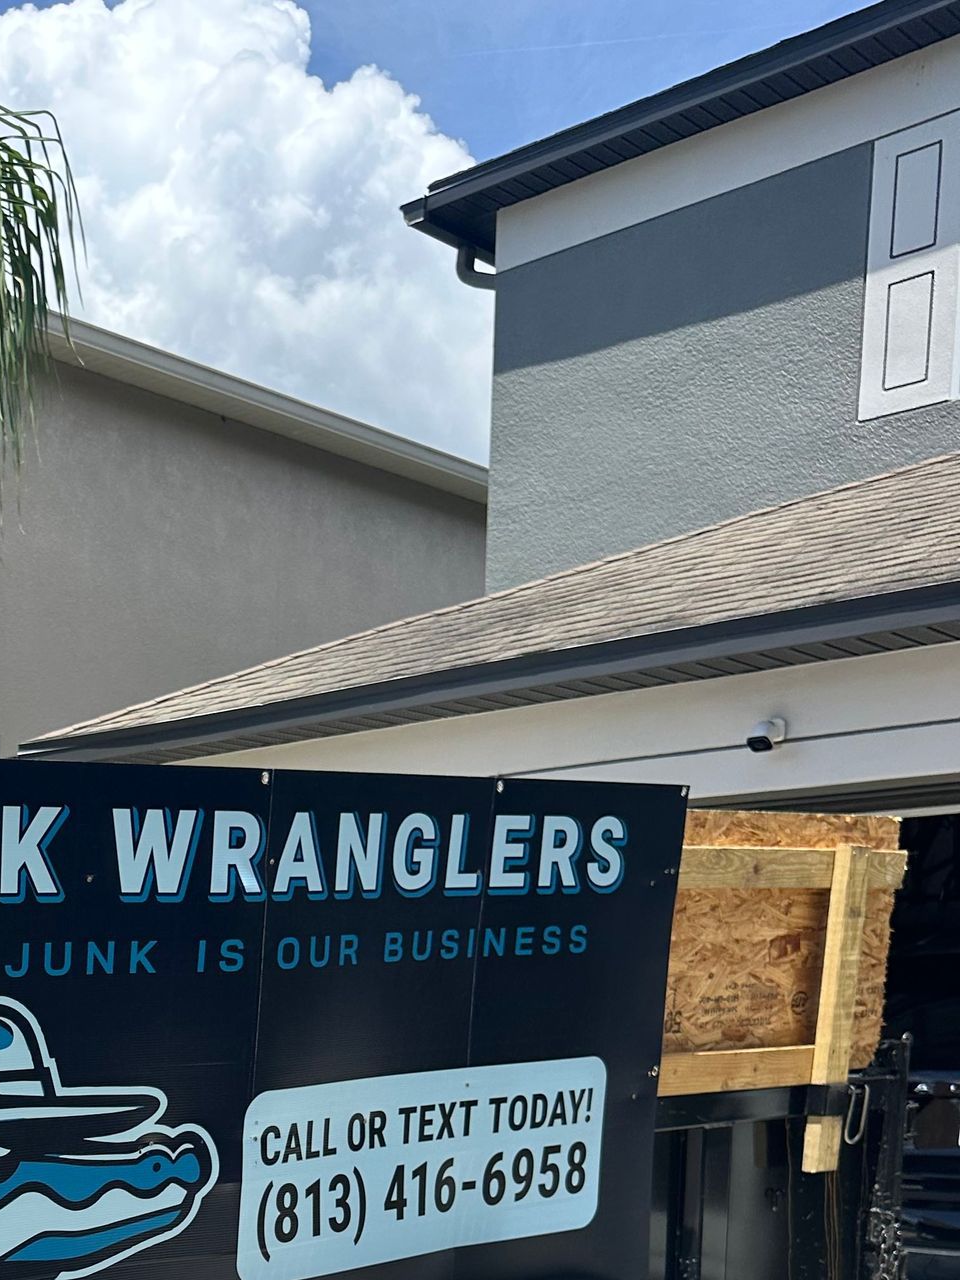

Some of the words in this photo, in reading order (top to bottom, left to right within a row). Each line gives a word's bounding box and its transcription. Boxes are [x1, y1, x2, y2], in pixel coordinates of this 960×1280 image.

[112, 806, 627, 902] WRANGLERS
[5, 940, 158, 978] JUNK
[197, 939, 245, 973] IS
[277, 934, 359, 969] OUR
[384, 924, 588, 964] BUSINESS
[259, 1118, 337, 1167] CALL
[347, 1110, 387, 1152] OR
[398, 1100, 479, 1145] TEXT
[489, 1087, 594, 1134] TODAY!
[257, 1165, 367, 1263] (813)
[383, 1141, 587, 1221] 416-6958
